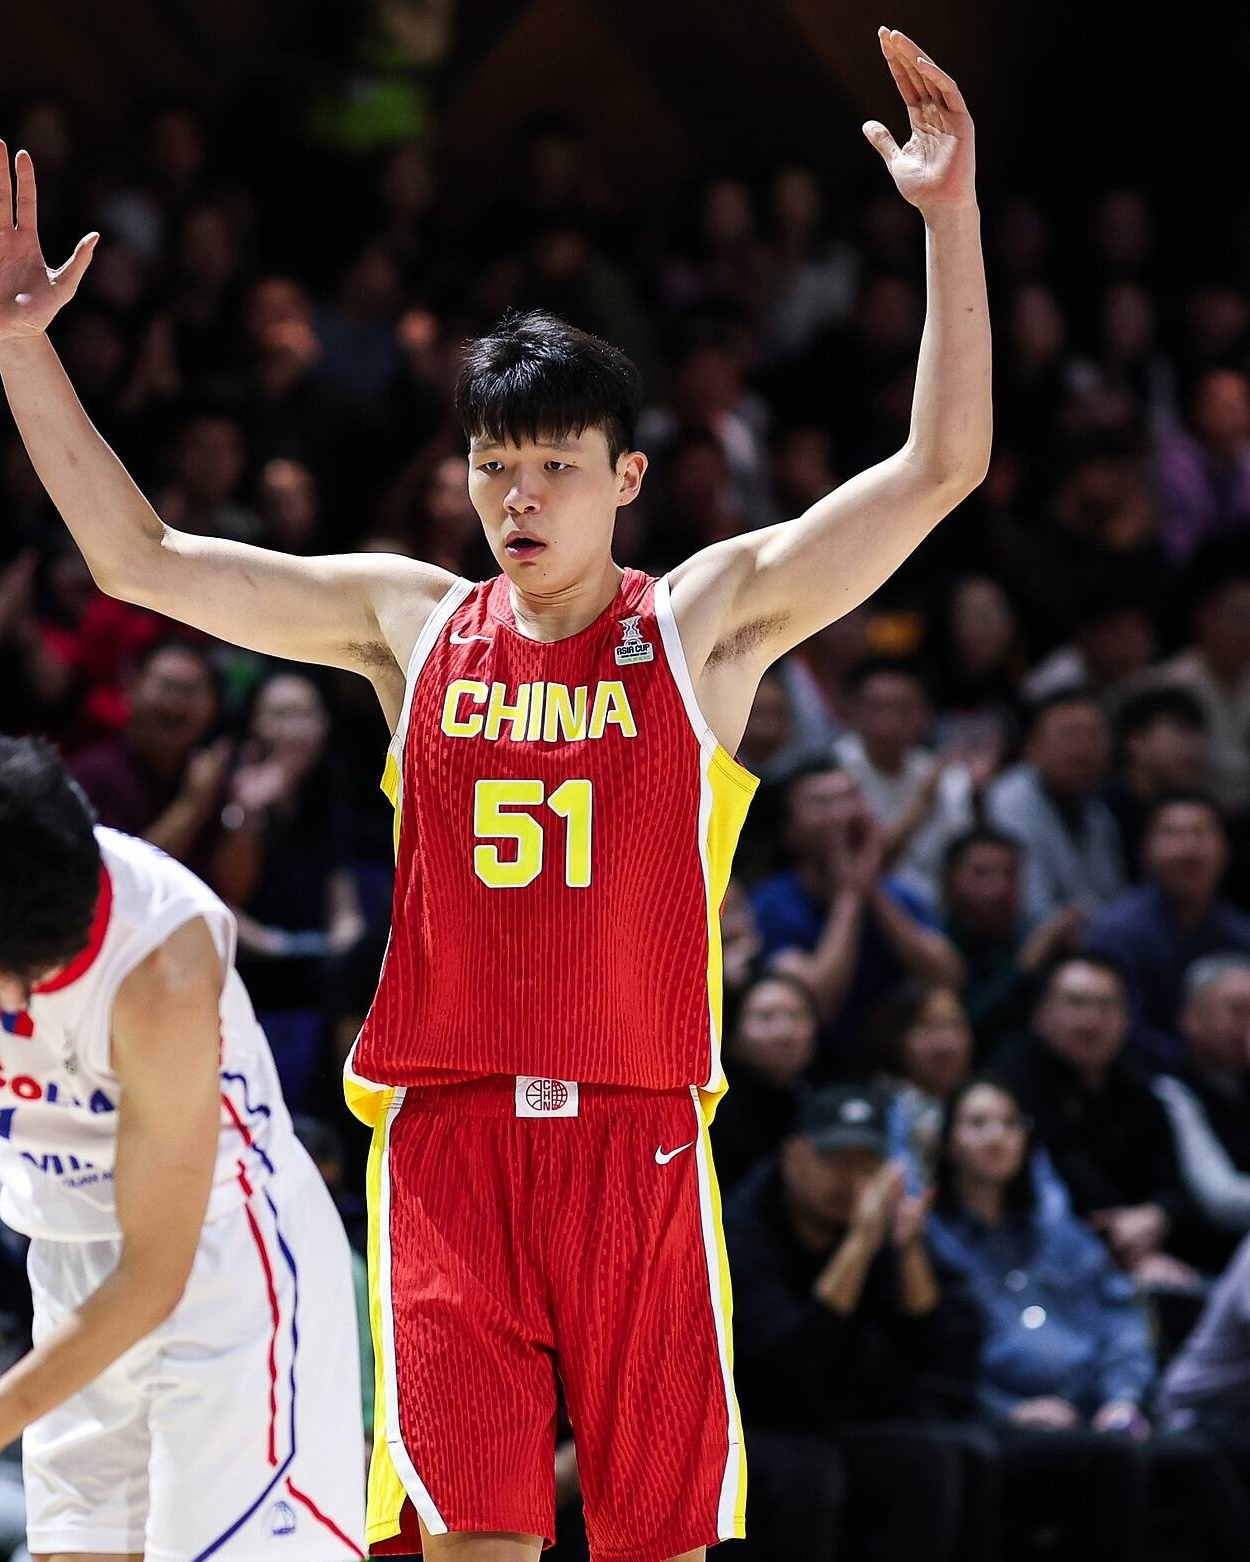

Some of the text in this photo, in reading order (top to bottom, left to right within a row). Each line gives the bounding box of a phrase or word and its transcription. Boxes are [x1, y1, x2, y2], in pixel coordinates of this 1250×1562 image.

[617, 646, 634, 655] ASIA
[635, 643, 650, 652] CUP
[441, 680, 638, 742] CHINA
[473, 778, 593, 889] 51
